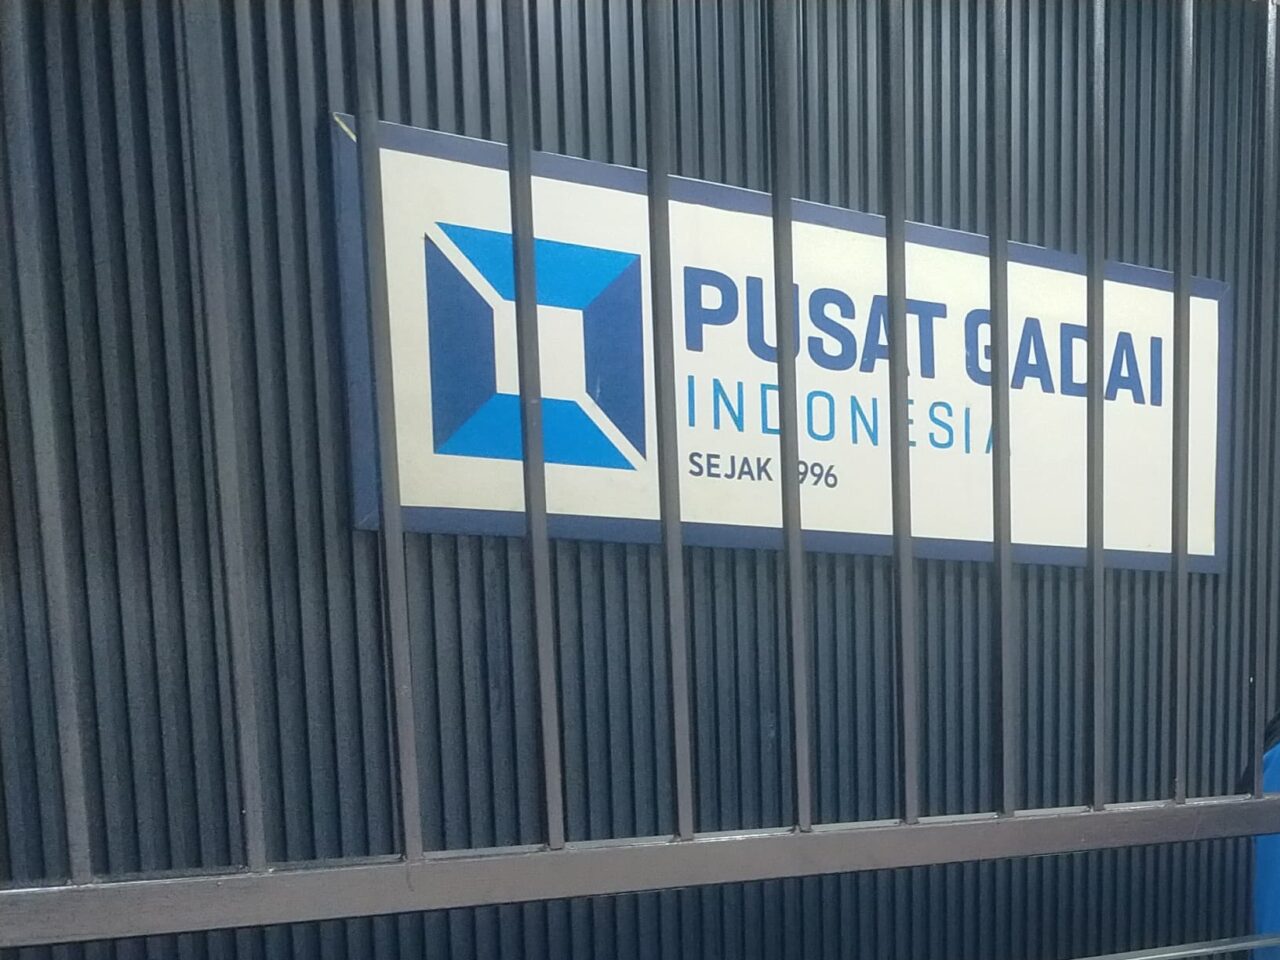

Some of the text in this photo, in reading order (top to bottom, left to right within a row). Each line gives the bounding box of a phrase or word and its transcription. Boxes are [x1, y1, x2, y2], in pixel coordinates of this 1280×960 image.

[683, 266, 1162, 407] PUSAT GADAI
[687, 375, 993, 455] INDONSI
[688, 451, 838, 488] SEJAK 996
